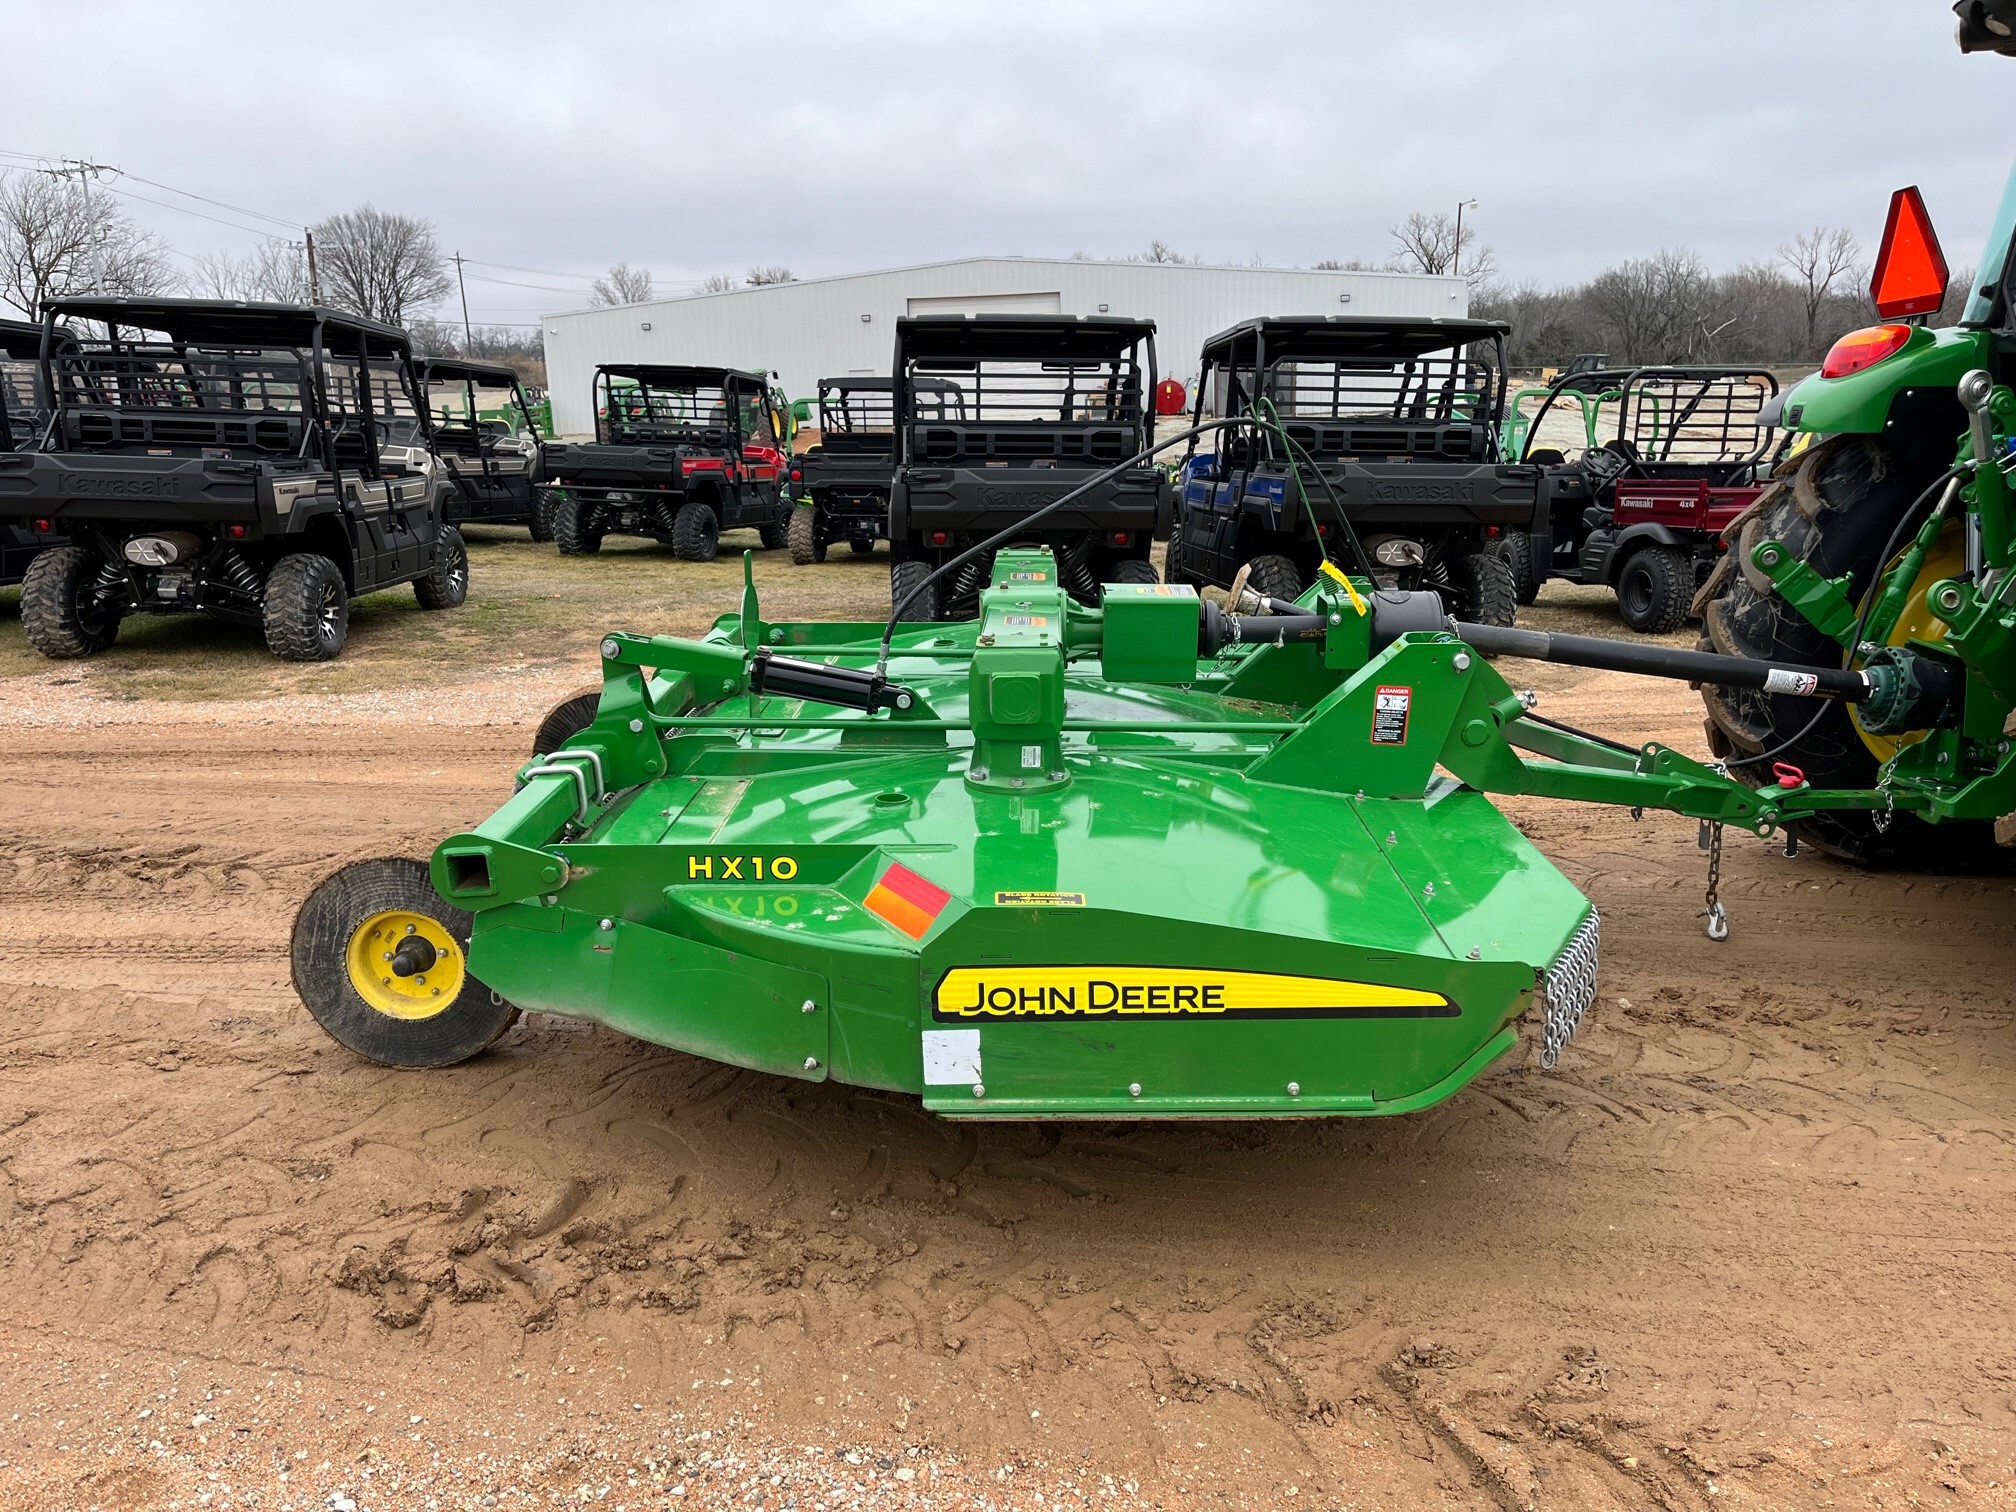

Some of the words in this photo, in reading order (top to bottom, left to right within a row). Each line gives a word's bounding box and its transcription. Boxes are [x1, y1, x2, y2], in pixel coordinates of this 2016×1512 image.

[58, 474, 180, 498] Kawasaki
[1367, 482, 1474, 500] Kawasaki
[1621, 498, 1653, 508] Kawasaki
[688, 855, 799, 880] HX10
[963, 982, 1076, 1012] JOHN
[1088, 981, 1225, 1010] DEERE
